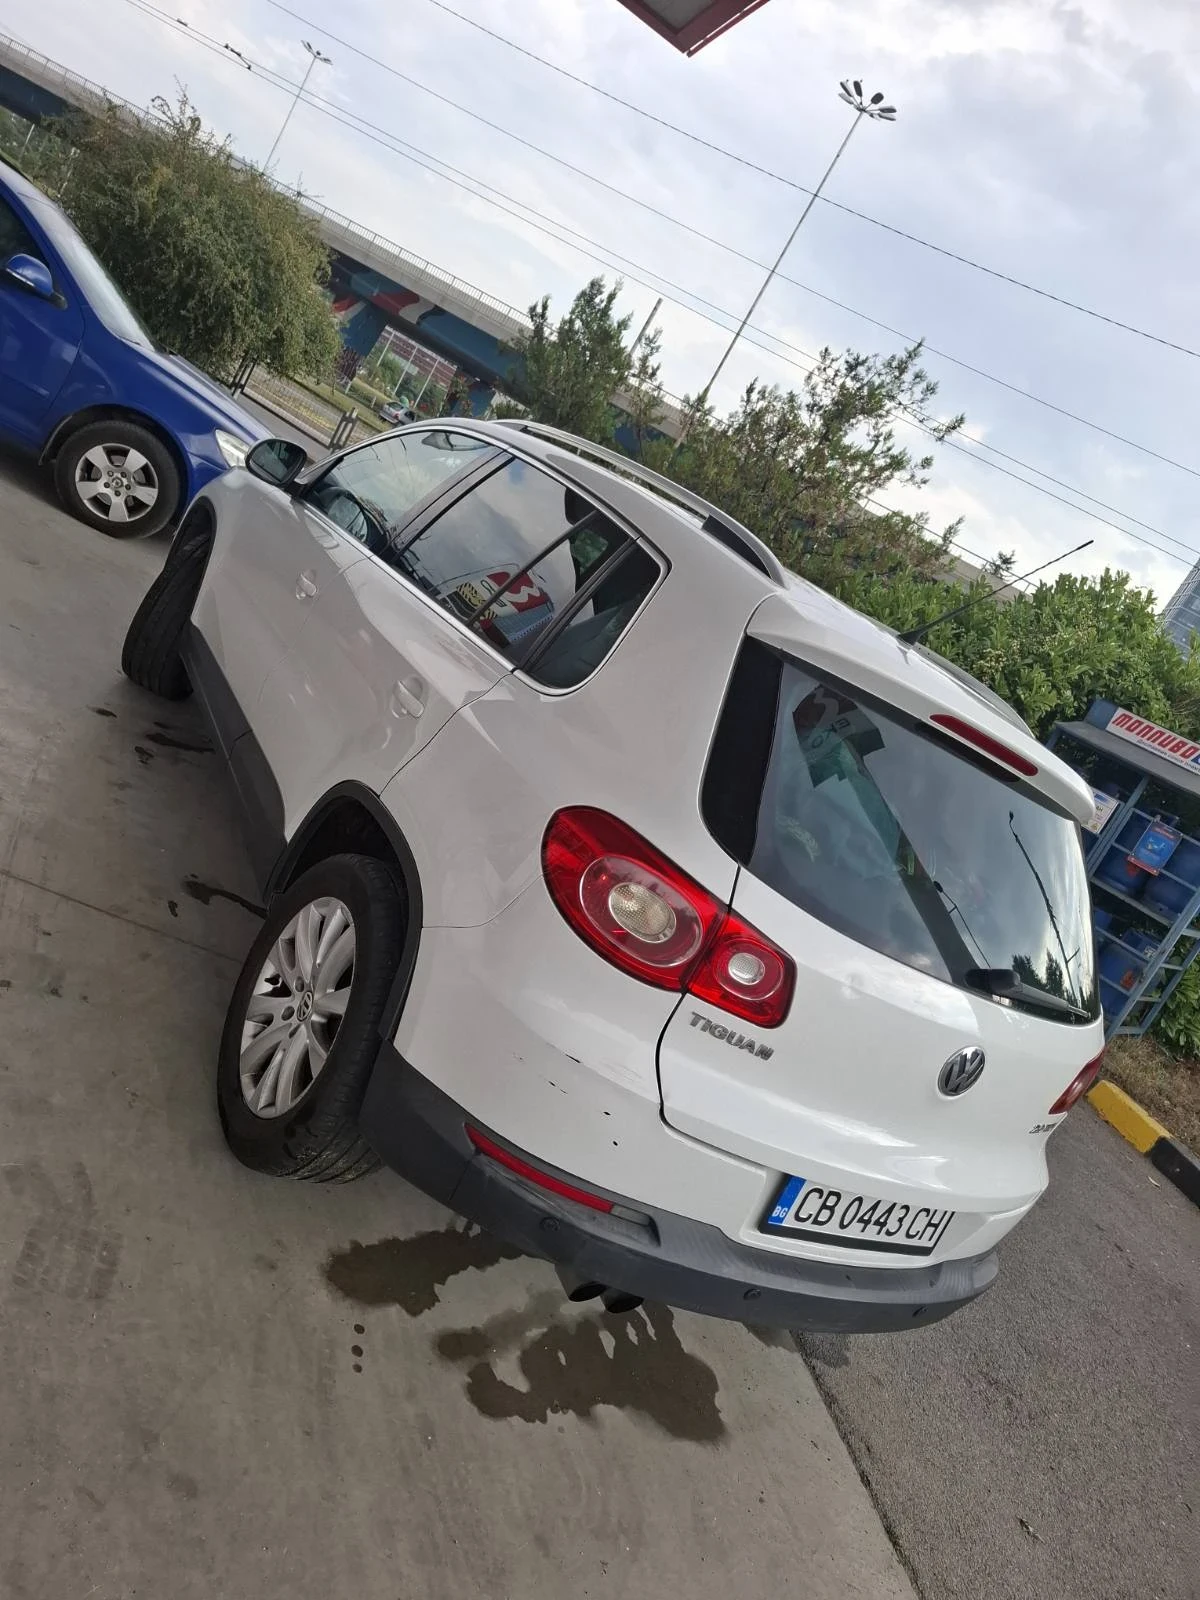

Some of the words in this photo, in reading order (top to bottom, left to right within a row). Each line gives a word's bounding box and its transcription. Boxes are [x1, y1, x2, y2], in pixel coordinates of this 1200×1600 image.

[689, 1011, 774, 1061] TIGUAN
[772, 1206, 788, 1218] BG
[794, 1187, 842, 1226] CB
[839, 1196, 911, 1237] 0443
[905, 1207, 948, 1242] CH
